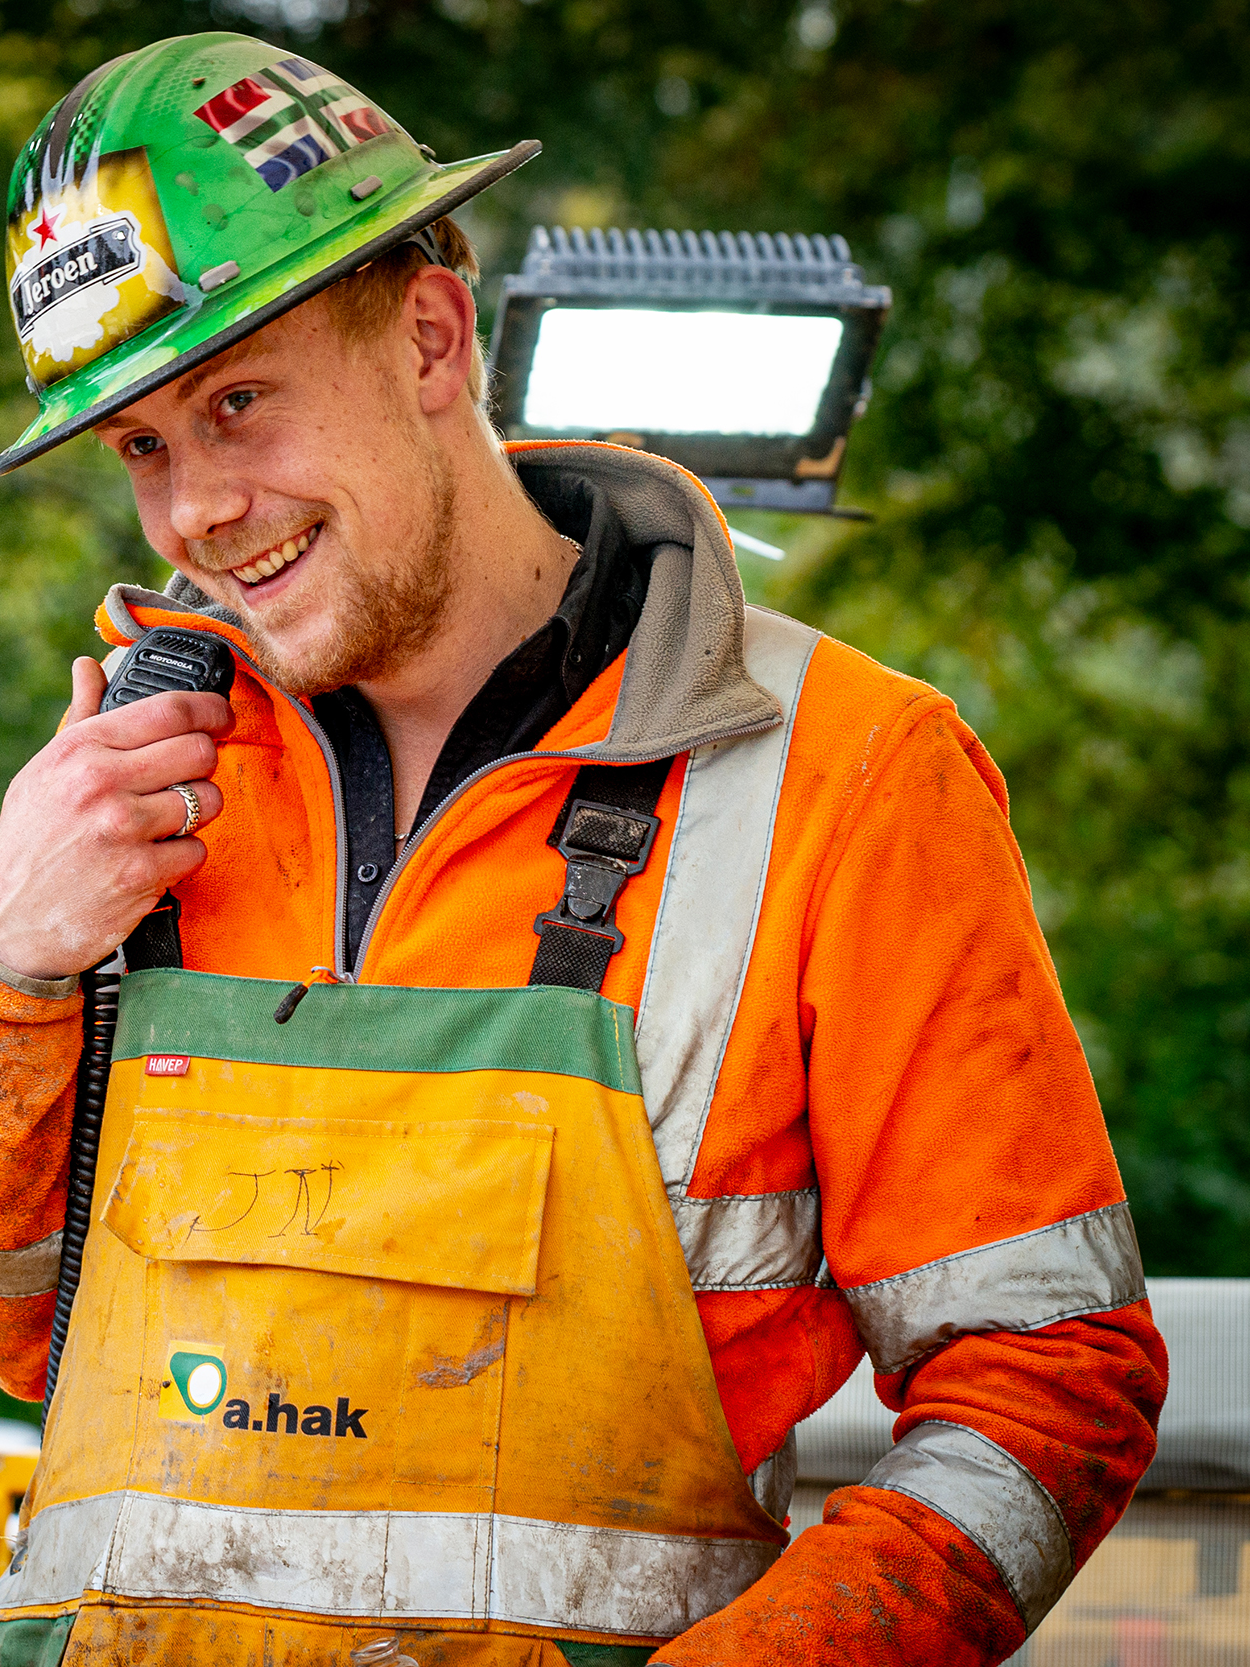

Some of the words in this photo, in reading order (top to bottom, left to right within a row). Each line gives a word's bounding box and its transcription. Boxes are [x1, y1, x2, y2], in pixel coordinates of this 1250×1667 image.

[23, 252, 98, 313] Jeroen
[149, 654, 193, 670] MOTOROLA
[149, 1058, 183, 1072] HAVEP
[222, 1392, 369, 1439] a.hak
